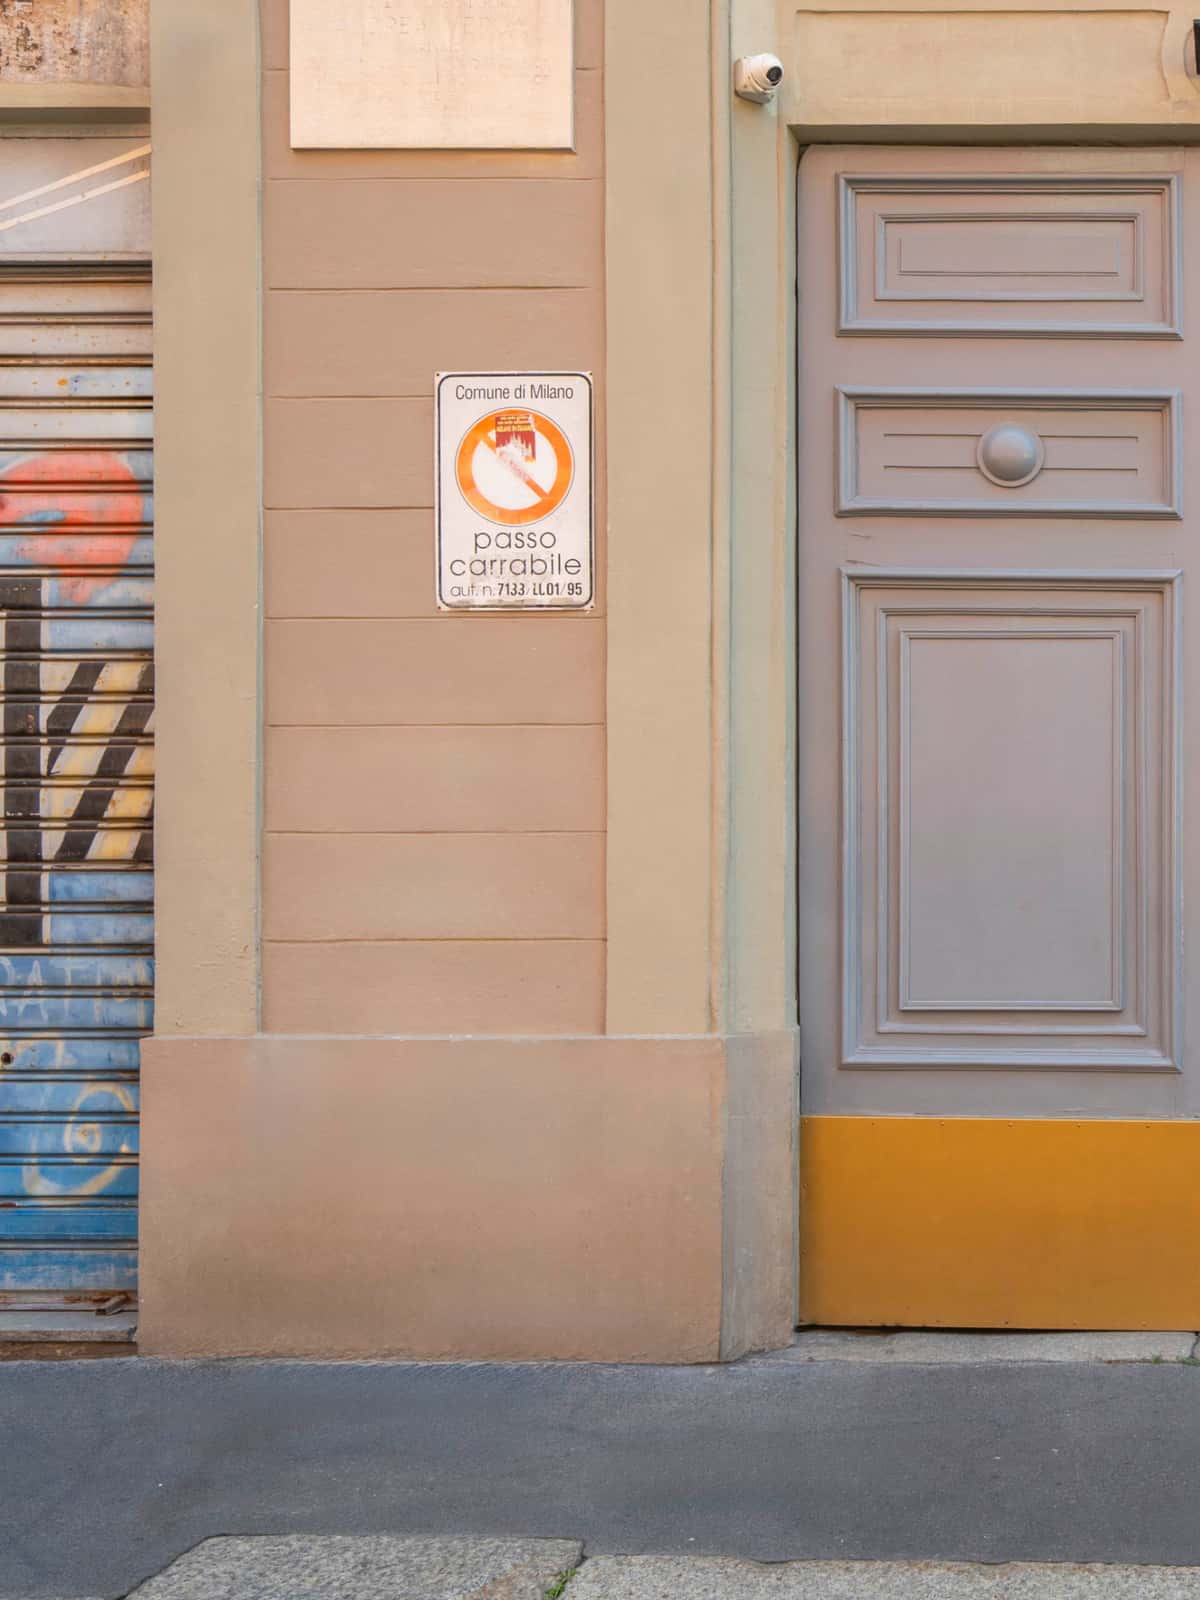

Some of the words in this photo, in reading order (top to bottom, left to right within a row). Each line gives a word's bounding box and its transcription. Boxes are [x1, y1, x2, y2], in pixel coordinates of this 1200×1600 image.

[455, 384, 510, 400] Comune
[514, 384, 526, 399] di
[530, 384, 574, 399] Milano
[474, 532, 556, 554] passo
[450, 553, 581, 576] carrabile
[450, 585, 479, 597] aut.
